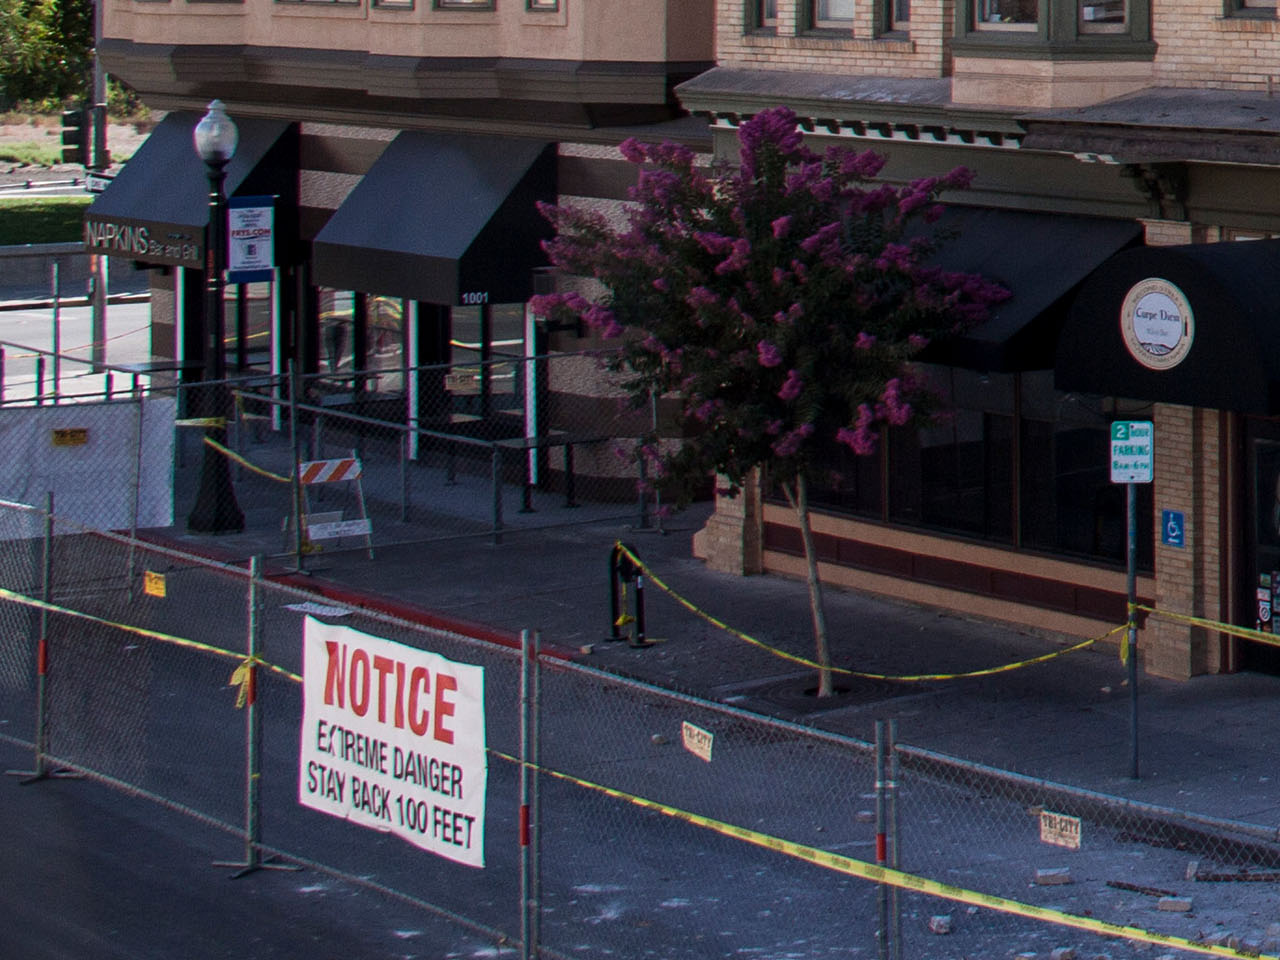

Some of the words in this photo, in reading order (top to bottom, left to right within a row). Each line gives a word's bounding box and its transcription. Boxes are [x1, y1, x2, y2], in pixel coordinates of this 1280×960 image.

[87, 221, 150, 254] NAPKINS
[462, 291, 488, 304] 1001
[1136, 307, 1157, 320] Carpe
[1160, 310, 1180, 321] Diem
[1116, 425, 1126, 438] 2
[1113, 445, 1150, 456] PARKING
[324, 641, 457, 745] NOTICE
[317, 719, 388, 775] EXTREME
[393, 746, 463, 800] DANGER
[307, 760, 346, 803] STAY
[352, 776, 392, 822] BACK
[396, 794, 428, 834] 100
[434, 806, 476, 850] FEET
[1043, 815, 1079, 835] TRI-CITY
